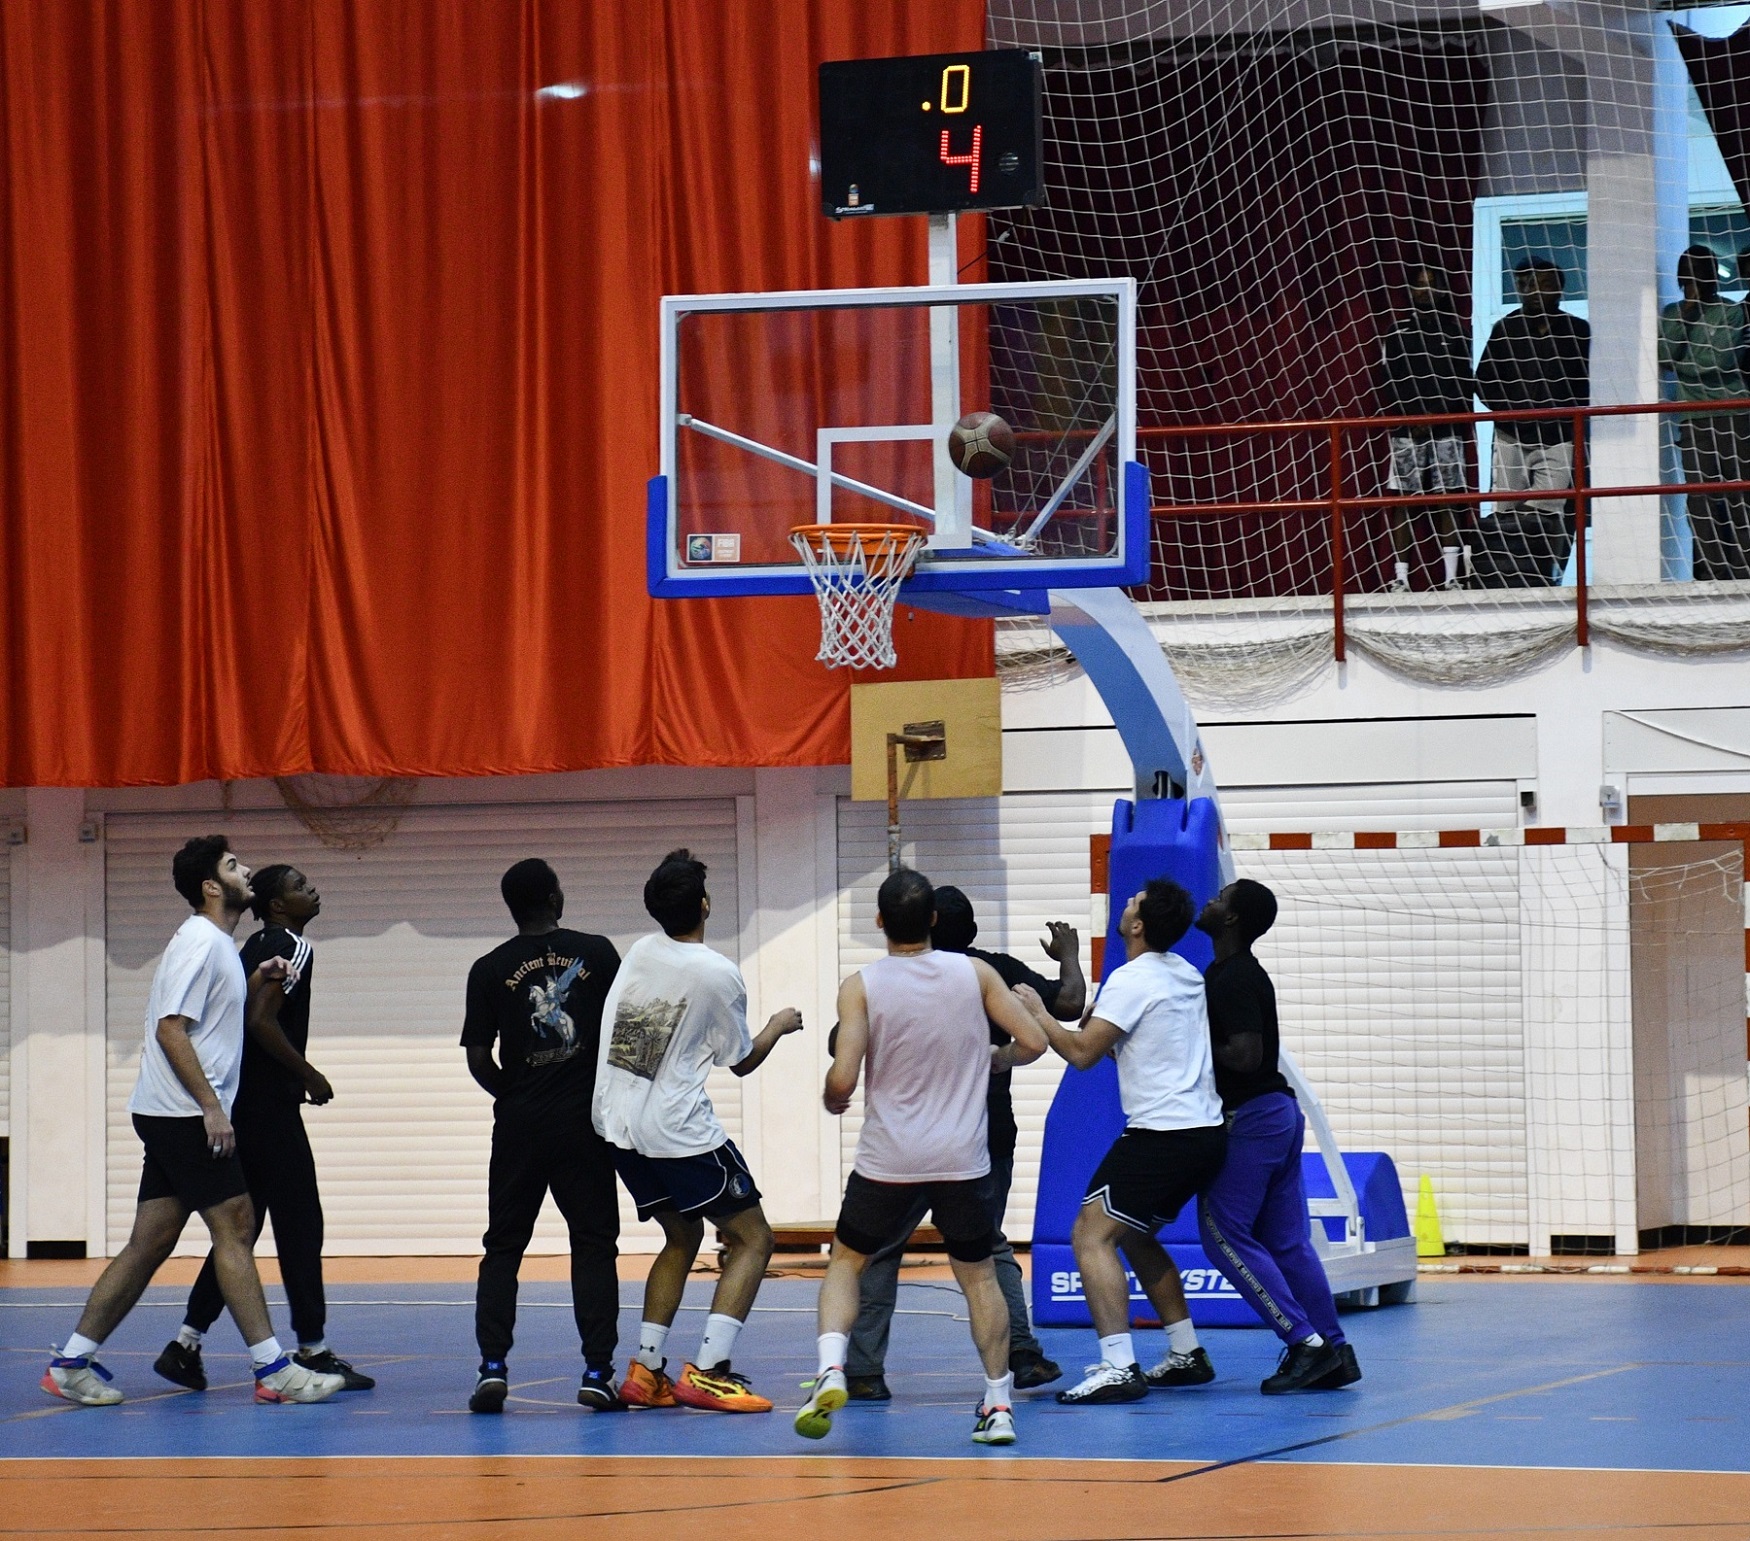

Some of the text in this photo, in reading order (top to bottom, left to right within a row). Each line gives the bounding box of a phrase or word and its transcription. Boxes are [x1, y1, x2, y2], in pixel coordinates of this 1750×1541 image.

[940, 125, 982, 193] 4
[505, 952, 591, 992] Ancient Revial
